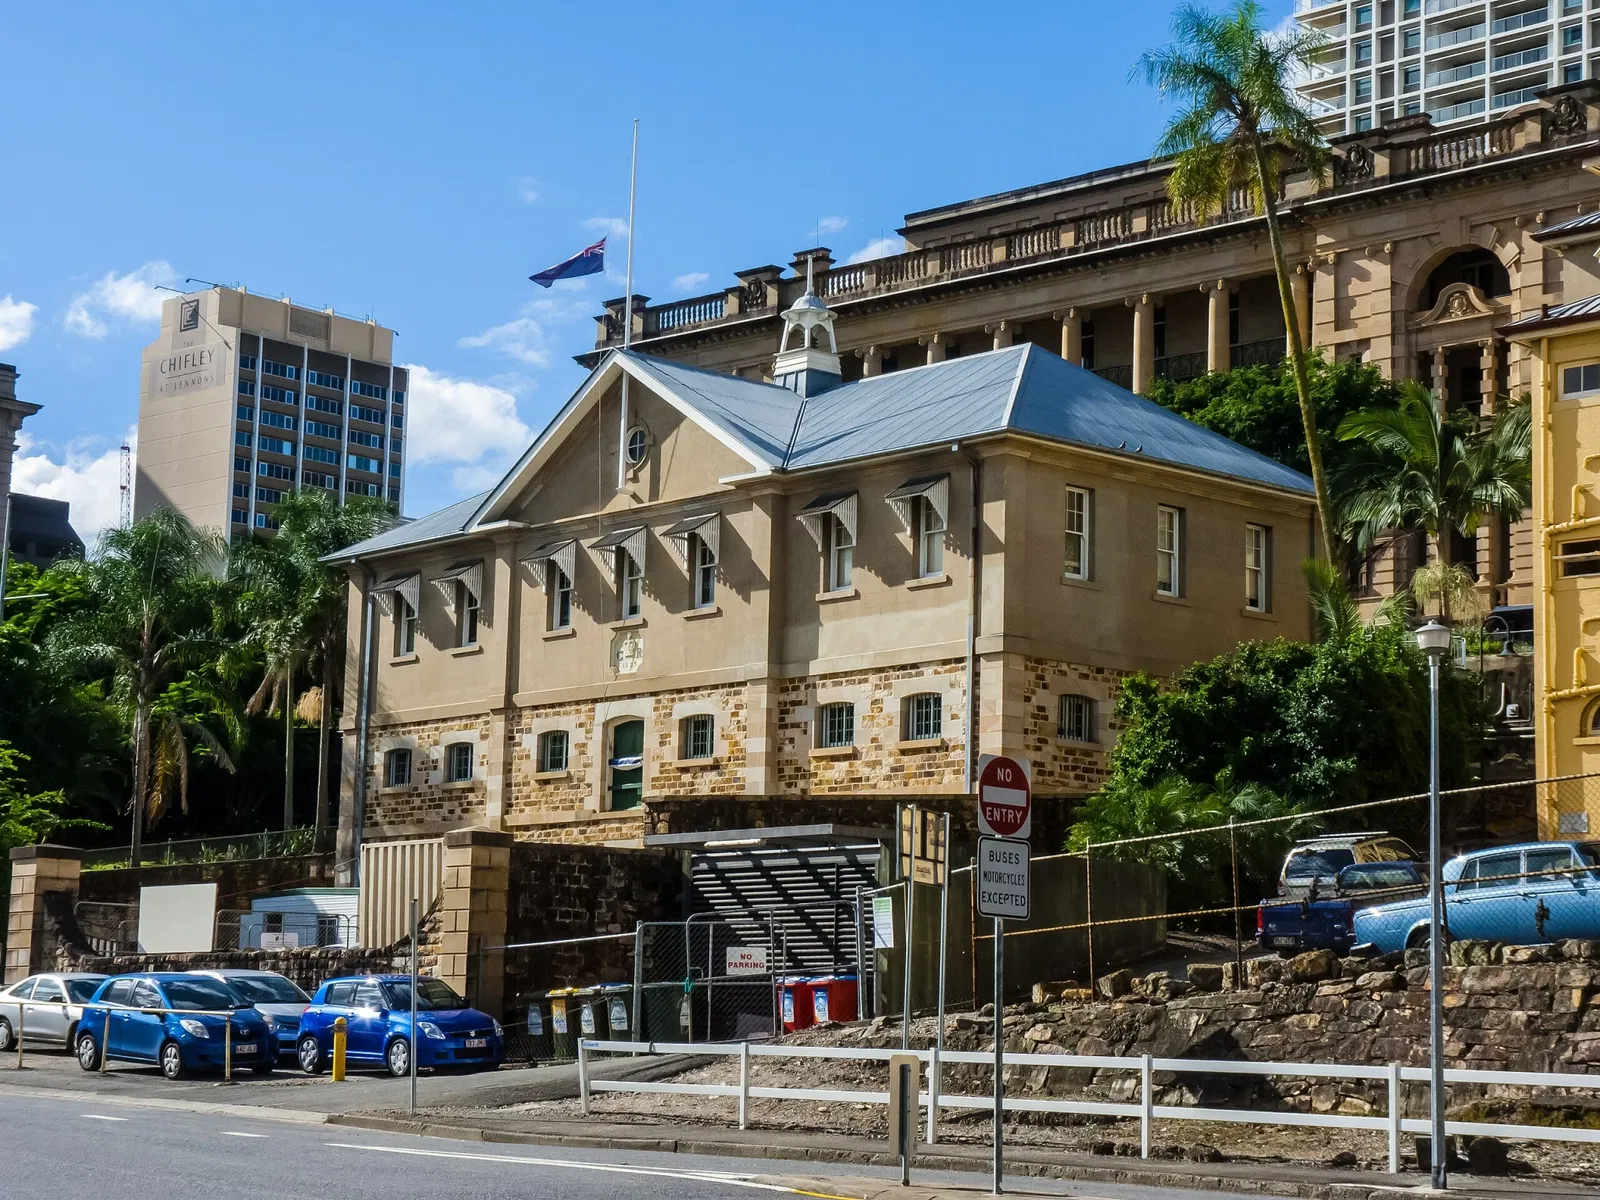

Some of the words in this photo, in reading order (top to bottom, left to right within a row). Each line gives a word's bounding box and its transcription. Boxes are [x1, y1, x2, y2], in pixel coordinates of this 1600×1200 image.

[183, 340, 195, 348] THE
[160, 348, 215, 374] CHIFLEY
[159, 384, 169, 393] AT
[174, 374, 214, 391] LENNONS
[997, 767, 1012, 783] NO
[986, 806, 1023, 824] ENTRY
[989, 850, 1020, 865] BUSES
[983, 870, 1025, 887] MOTORCYCLES
[982, 891, 1026, 907] EXCEPTED
